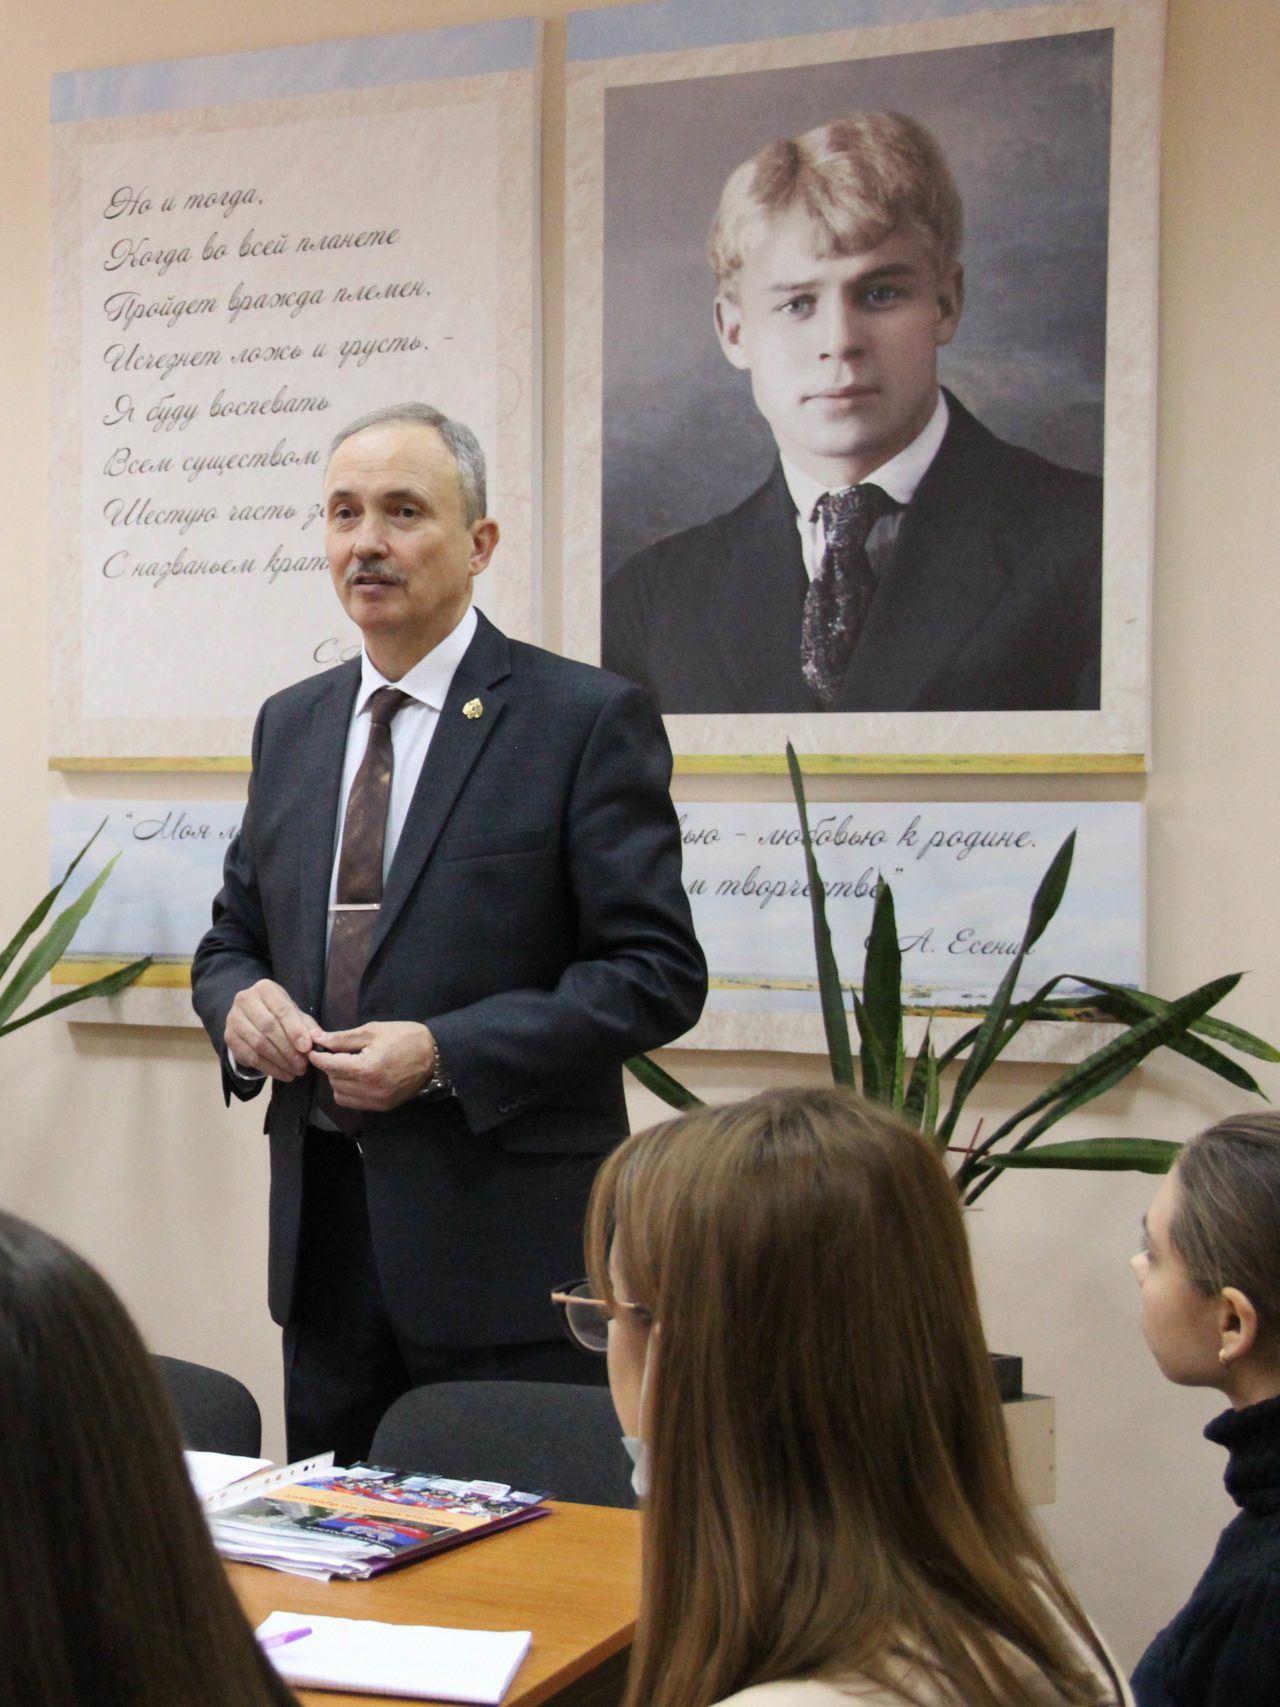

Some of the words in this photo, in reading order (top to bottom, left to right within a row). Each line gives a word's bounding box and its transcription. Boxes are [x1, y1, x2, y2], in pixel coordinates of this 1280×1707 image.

[103, 185, 153, 219] Но
[161, 196, 176, 212] и
[103, 237, 192, 276] Когда
[202, 231, 229, 261] во
[239, 228, 290, 257] всей
[295, 228, 401, 253] планете
[103, 291, 218, 331] Пройдет
[228, 281, 324, 324] вражда
[103, 342, 222, 381] Исчезнет
[230, 344, 305, 364] ложь
[312, 343, 328, 358] и
[102, 394, 135, 426] Я
[146, 393, 199, 433] буду
[209, 385, 332, 418] воспевать
[103, 447, 174, 477] Всем
[182, 438, 321, 483] существом
[102, 497, 219, 535] Шестую
[228, 503, 299, 522] часть
[102, 550, 130, 579] С
[131, 547, 256, 588] названьем
[896, 815, 921, 847] к
